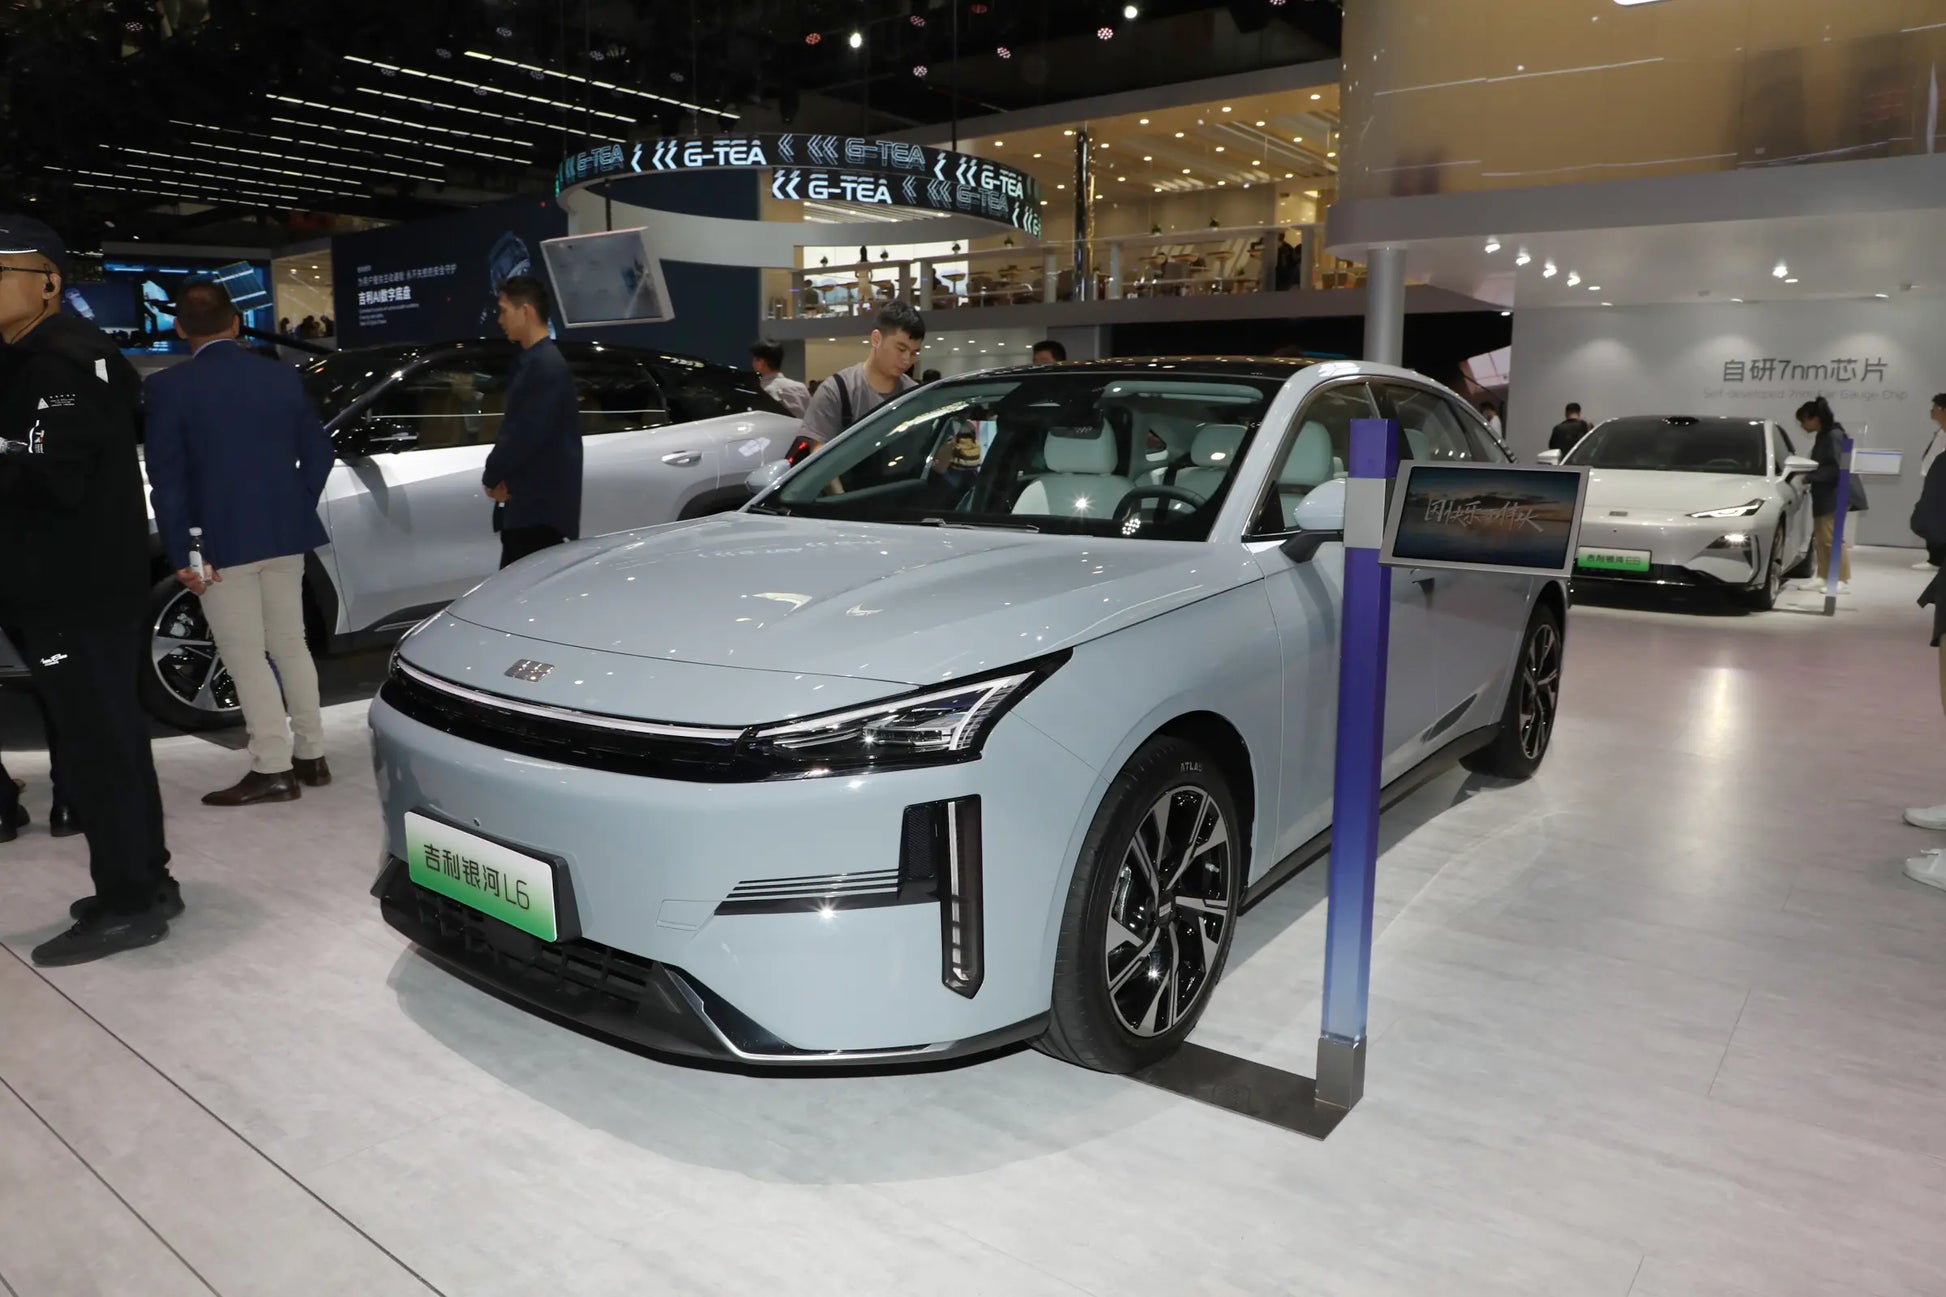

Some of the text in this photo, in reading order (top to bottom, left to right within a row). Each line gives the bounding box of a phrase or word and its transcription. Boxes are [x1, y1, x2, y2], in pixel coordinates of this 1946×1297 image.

[576, 138, 1023, 198] G-TEA G-TEA G-TEA G-TEA
[808, 173, 1009, 216] G-TEA G-TEA
[358, 286, 411, 306] 吉利AI数字底盘
[1723, 357, 1888, 382] 自研7nm芯片
[424, 844, 530, 910] 吉利银河L6
